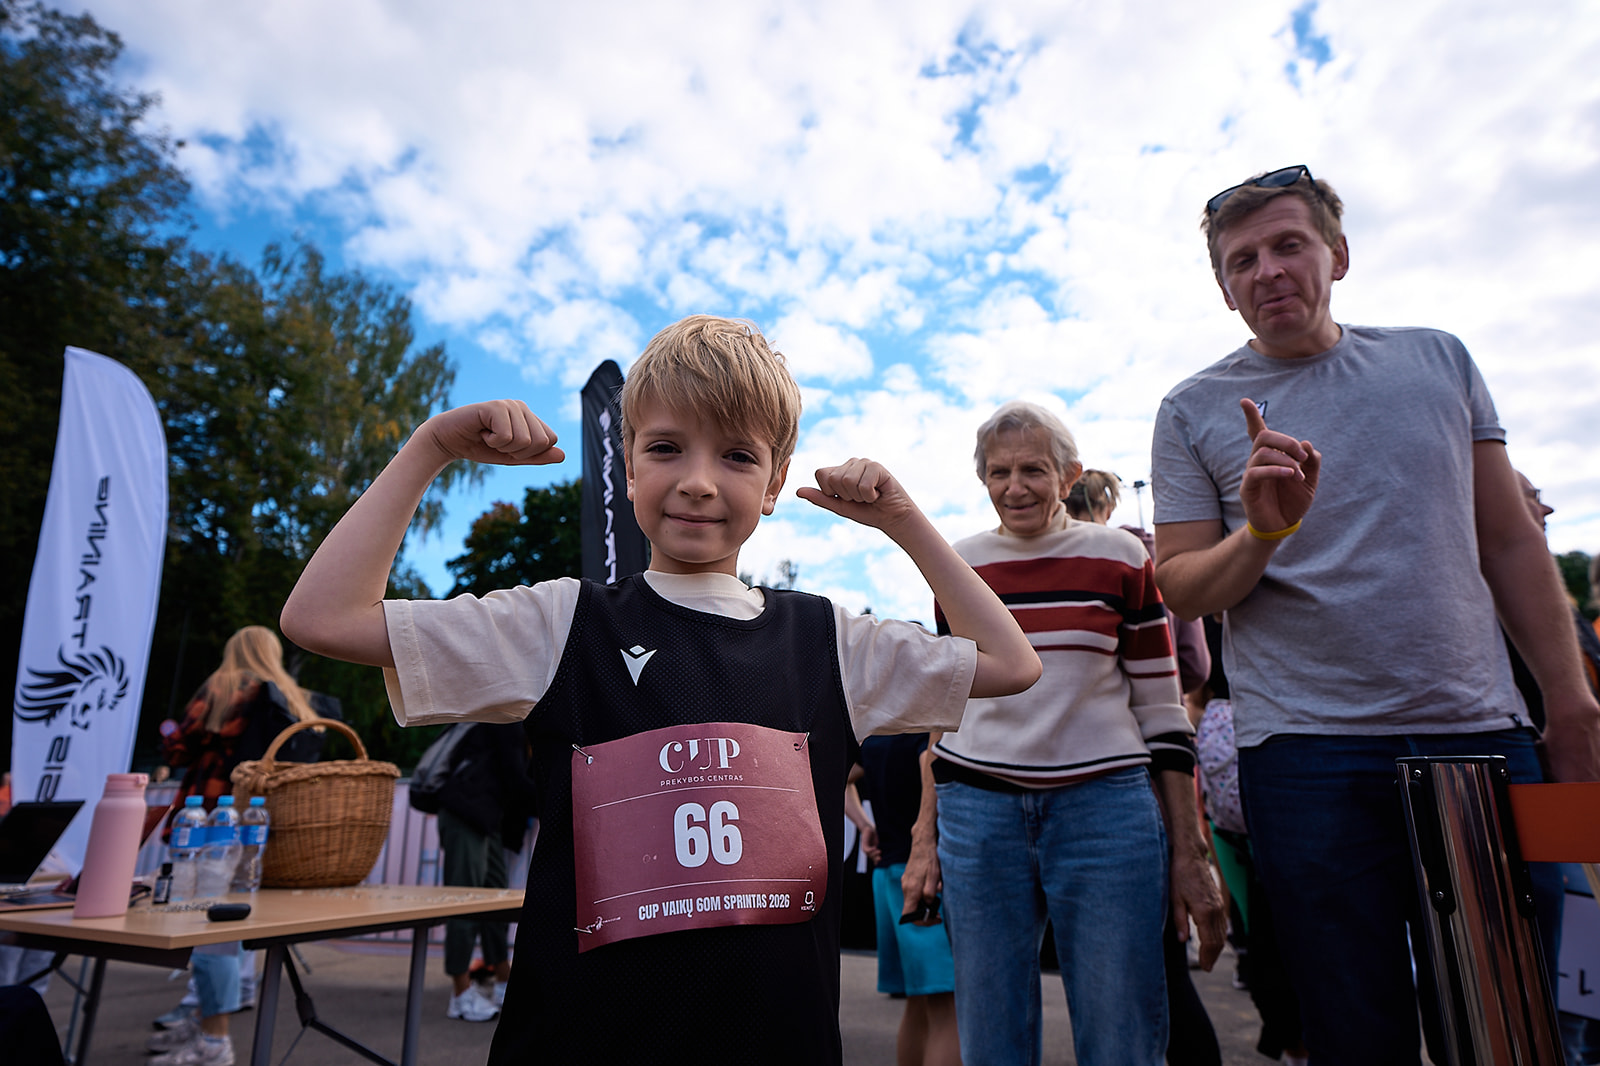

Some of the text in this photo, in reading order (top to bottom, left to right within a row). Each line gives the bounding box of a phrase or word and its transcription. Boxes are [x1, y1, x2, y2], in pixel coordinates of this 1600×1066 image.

[659, 737, 741, 773] CUP
[660, 774, 744, 787] PREKYBOS CENTRAS
[673, 800, 743, 868] 66
[638, 903, 660, 921] CUP
[662, 898, 694, 918] VAIKŲ
[696, 896, 721, 912] 60M
[724, 893, 767, 910] SPRINTAS
[769, 893, 790, 909] 2026
